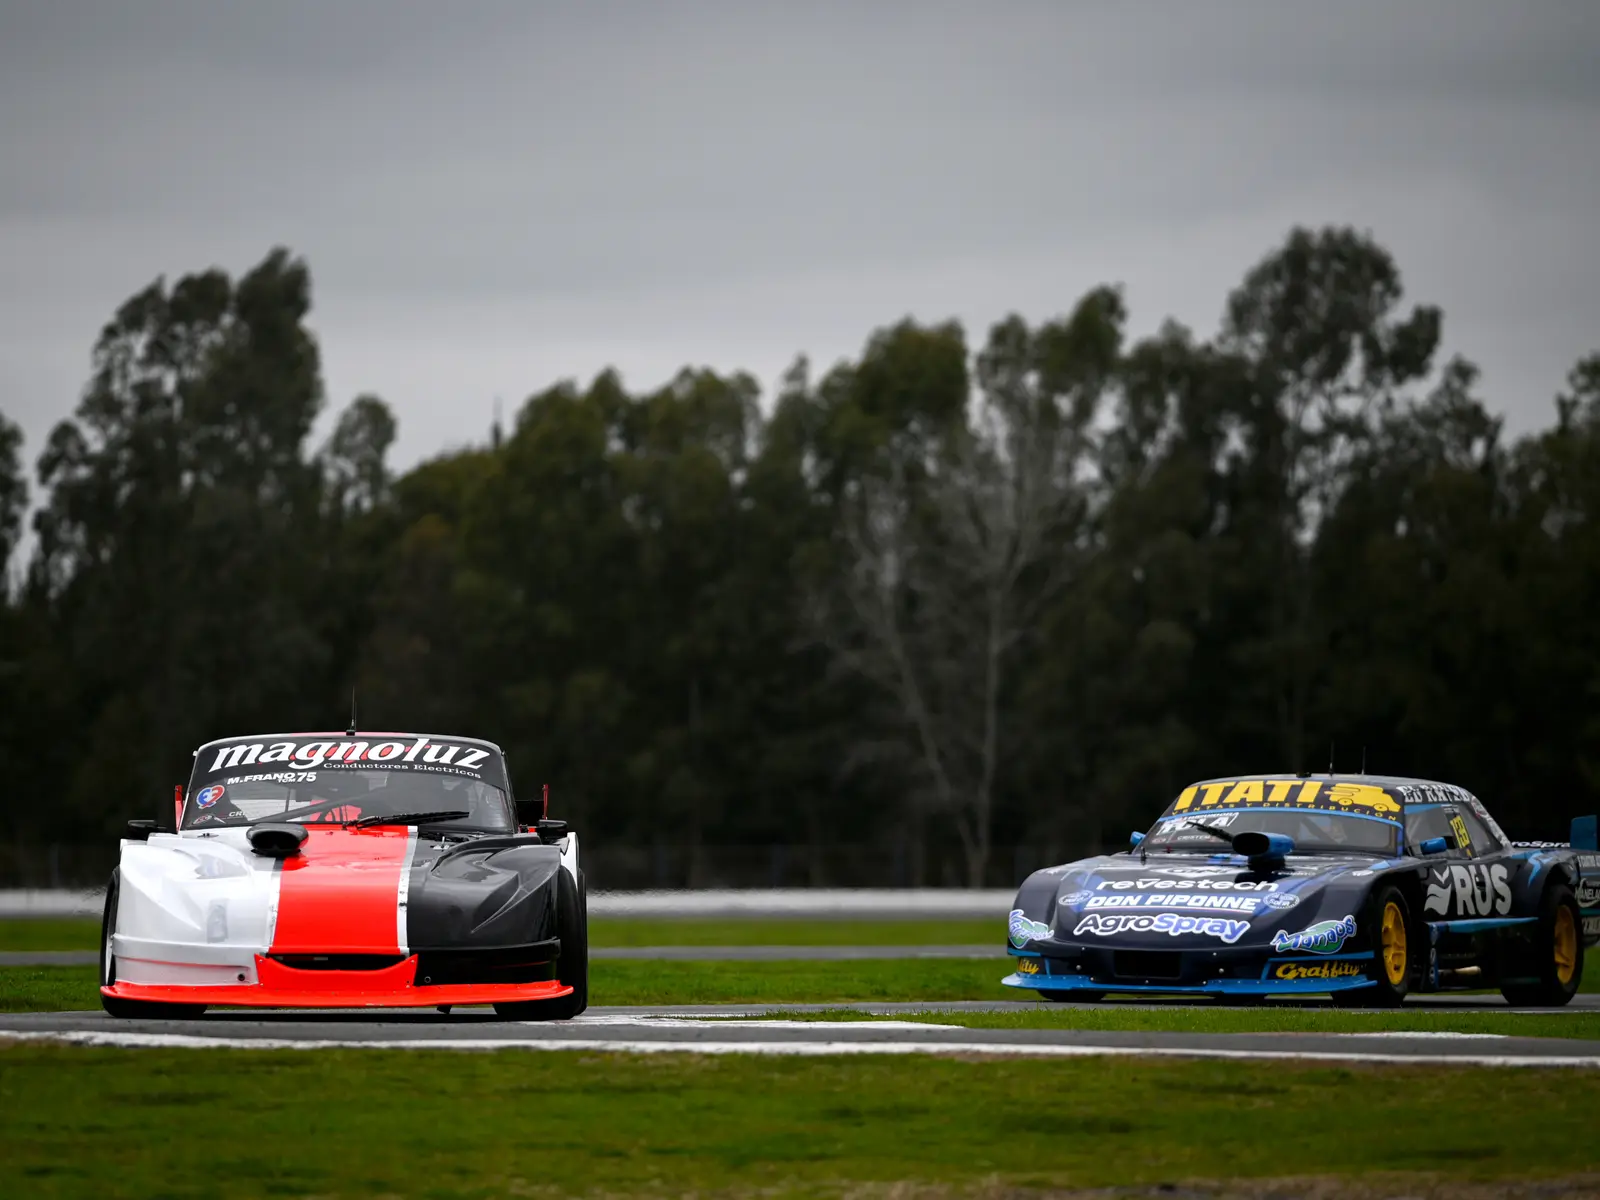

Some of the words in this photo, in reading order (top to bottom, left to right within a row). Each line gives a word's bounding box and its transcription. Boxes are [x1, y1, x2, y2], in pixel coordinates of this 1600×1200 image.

[208, 738, 490, 773] magnoluz
[296, 772, 317, 783] 75
[323, 762, 409, 770] Conductores
[413, 763, 482, 779] Electricos
[1174, 780, 1324, 811] ITATI
[1171, 803, 1235, 816] VENTAS
[1096, 878, 1279, 892] revestech
[1450, 863, 1512, 916] RUS
[1086, 895, 1143, 907] DON
[1145, 894, 1261, 910] PIPONNE
[1073, 913, 1251, 944] AgroSpray
[1275, 961, 1361, 980] Graffity
